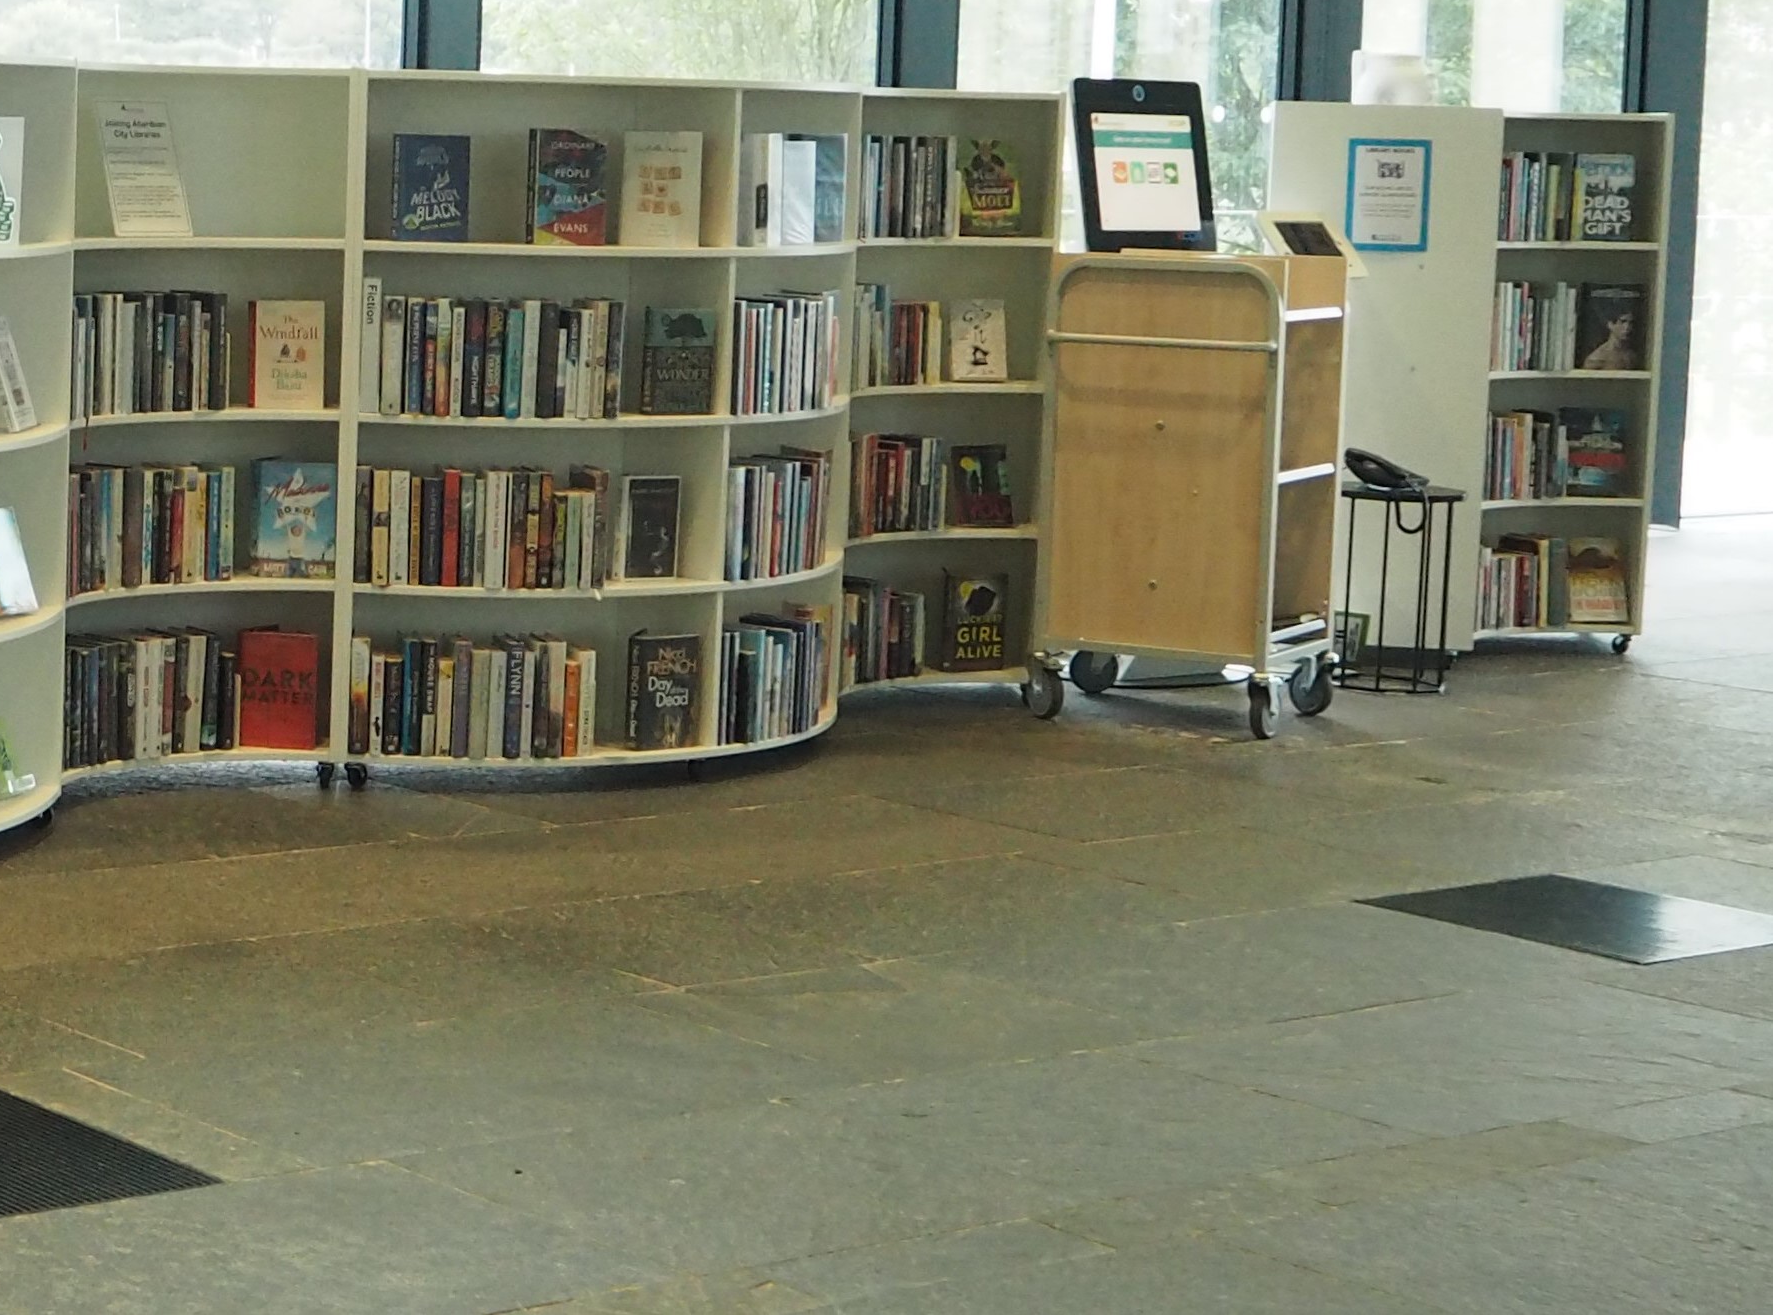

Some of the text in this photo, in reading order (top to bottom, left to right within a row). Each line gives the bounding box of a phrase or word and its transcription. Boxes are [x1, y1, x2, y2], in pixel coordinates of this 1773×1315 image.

[554, 168, 590, 179] PEOPLE
[411, 187, 461, 206] MELODY
[554, 193, 590, 205] DIANA
[1584, 194, 1630, 209] DEAD
[416, 202, 461, 222] BLACK
[553, 223, 588, 234] EVANS
[1585, 222, 1624, 235] GIFT
[366, 284, 378, 325] Fiction
[260, 325, 318, 340] Windfall
[957, 626, 1002, 643] GIRL
[955, 644, 1002, 659] ALIVE
[510, 651, 523, 695] FLYNN
[647, 660, 697, 675] FRENCH
[243, 667, 315, 690] DARK
[648, 676, 673, 694] Day
[655, 688, 689, 708] Dead
